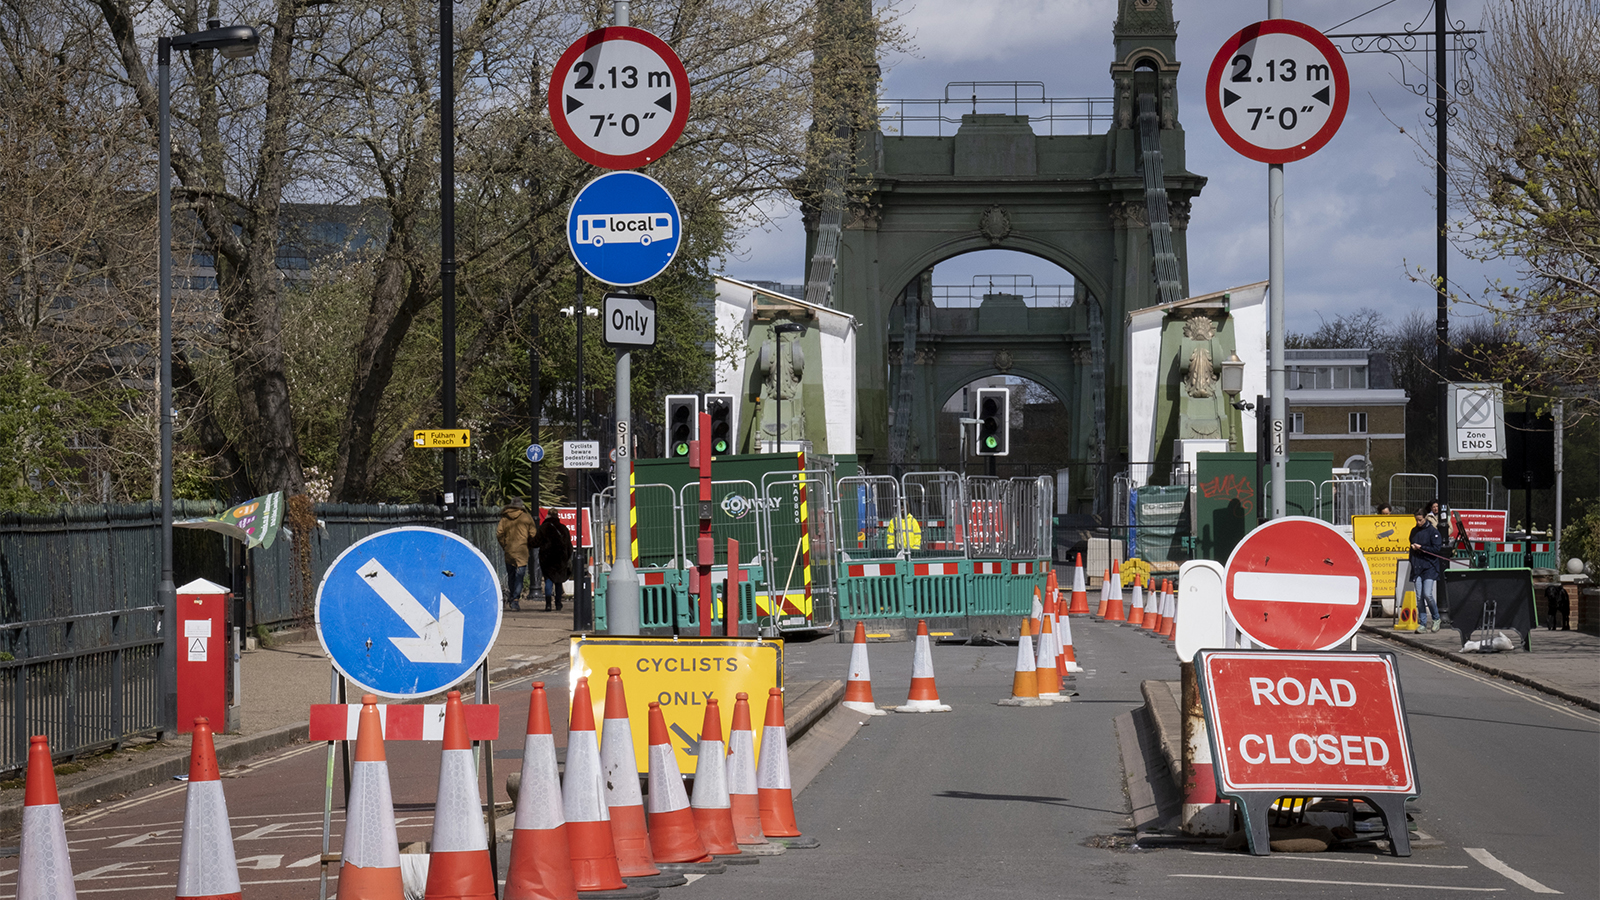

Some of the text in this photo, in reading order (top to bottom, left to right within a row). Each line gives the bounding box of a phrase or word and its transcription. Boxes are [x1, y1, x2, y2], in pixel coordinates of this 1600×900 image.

[573, 61, 671, 90] 2.13 m
[1231, 54, 1330, 83] 2.13 m
[610, 216, 654, 232] local
[612, 308, 649, 336] Only
[1466, 431, 1487, 439] Zone
[1461, 440, 1493, 450] ENDS
[720, 497, 783, 511] CONWAY
[636, 657, 738, 673] CYCLISTS
[657, 691, 714, 706] ONLY
[1249, 677, 1357, 707] ROAD
[1239, 734, 1390, 766] CLOSED
